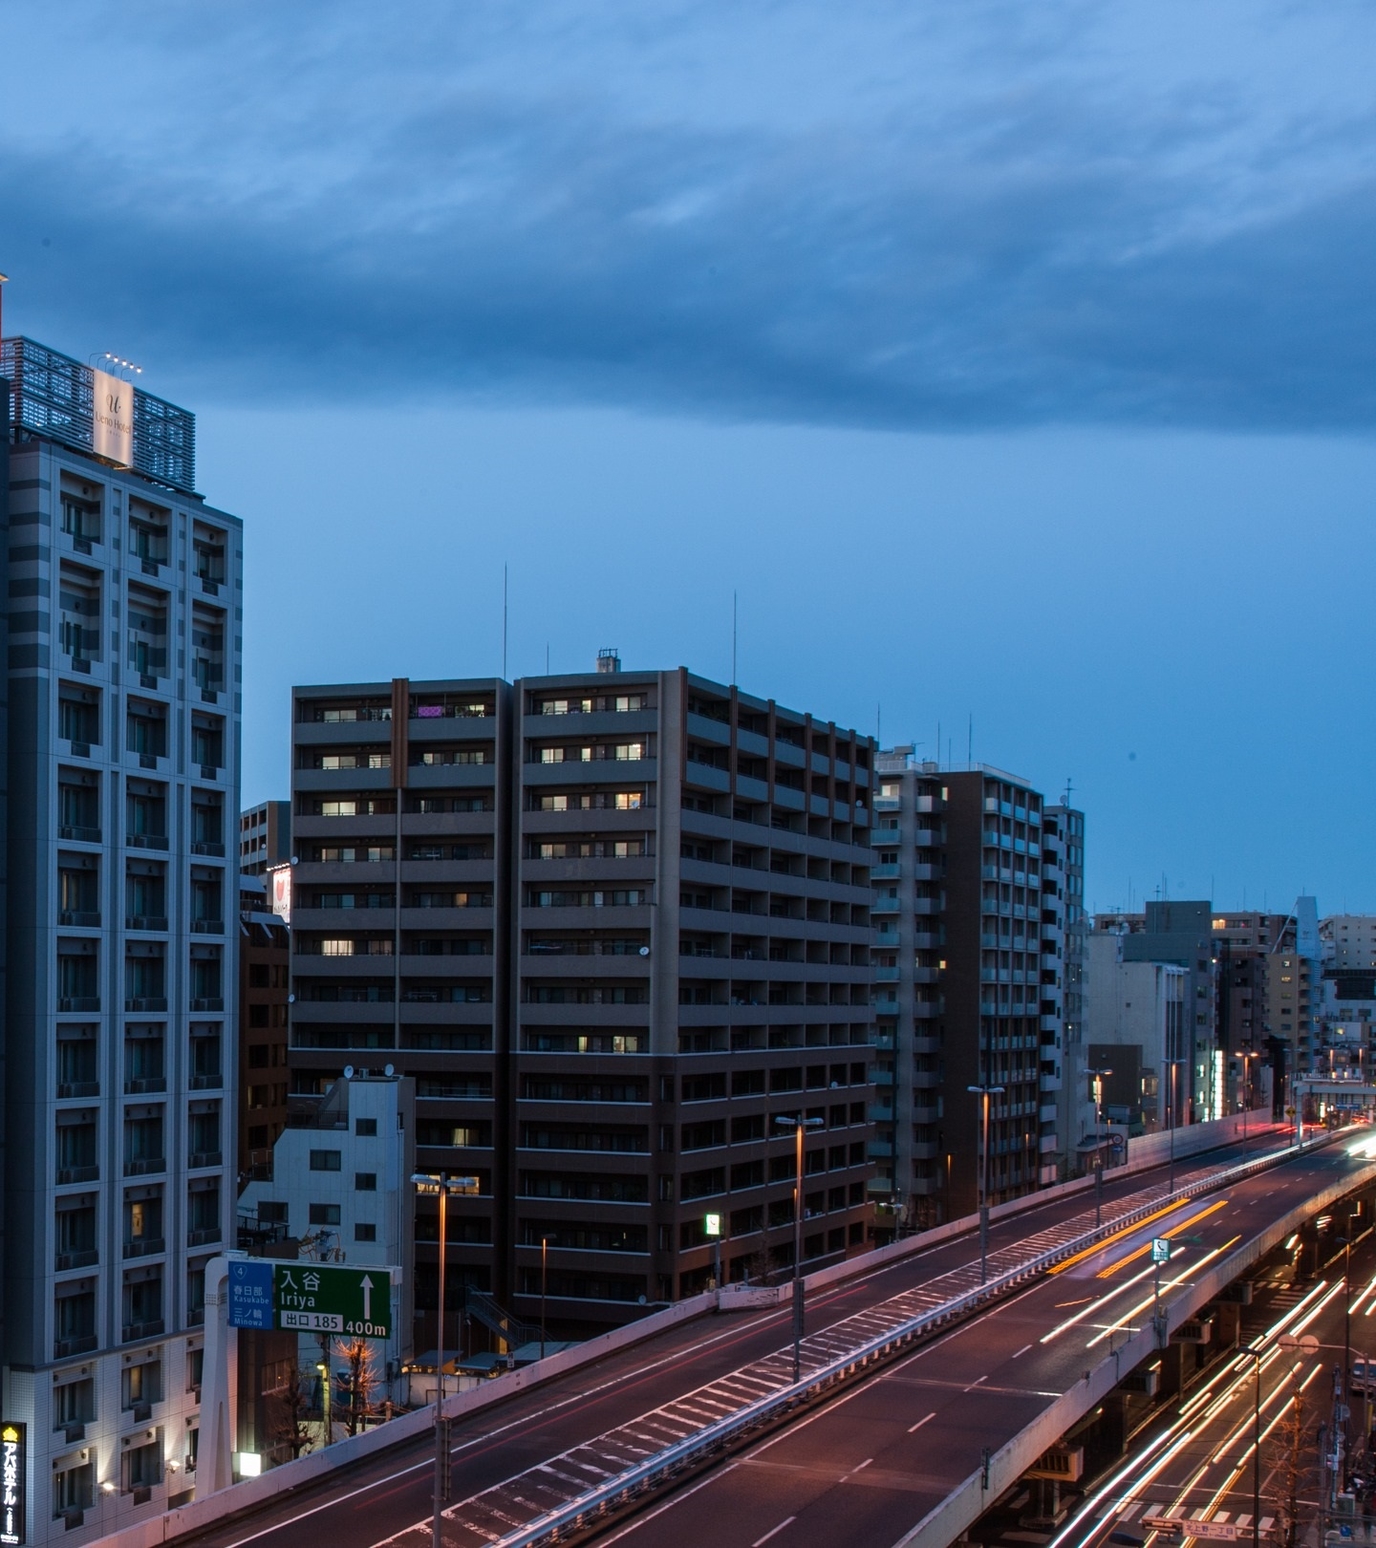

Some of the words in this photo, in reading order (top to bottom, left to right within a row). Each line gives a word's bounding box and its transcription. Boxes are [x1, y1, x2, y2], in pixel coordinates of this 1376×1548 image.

[95, 411, 113, 427] Ueno
[114, 419, 131, 435] Hotel
[237, 1267, 244, 1276] 4
[280, 1270, 321, 1292] 入谷
[233, 1285, 263, 1296] 春日部
[233, 1295, 270, 1305] Kasukabe
[281, 1292, 315, 1309] Iriya
[234, 1307, 263, 1319] 三ノ輪
[286, 1313, 309, 1326] 出口
[314, 1315, 338, 1329] 185
[234, 1317, 263, 1327] Minowa
[345, 1320, 386, 1336] 400m
[3, 1442, 17, 1506] アパホテル
